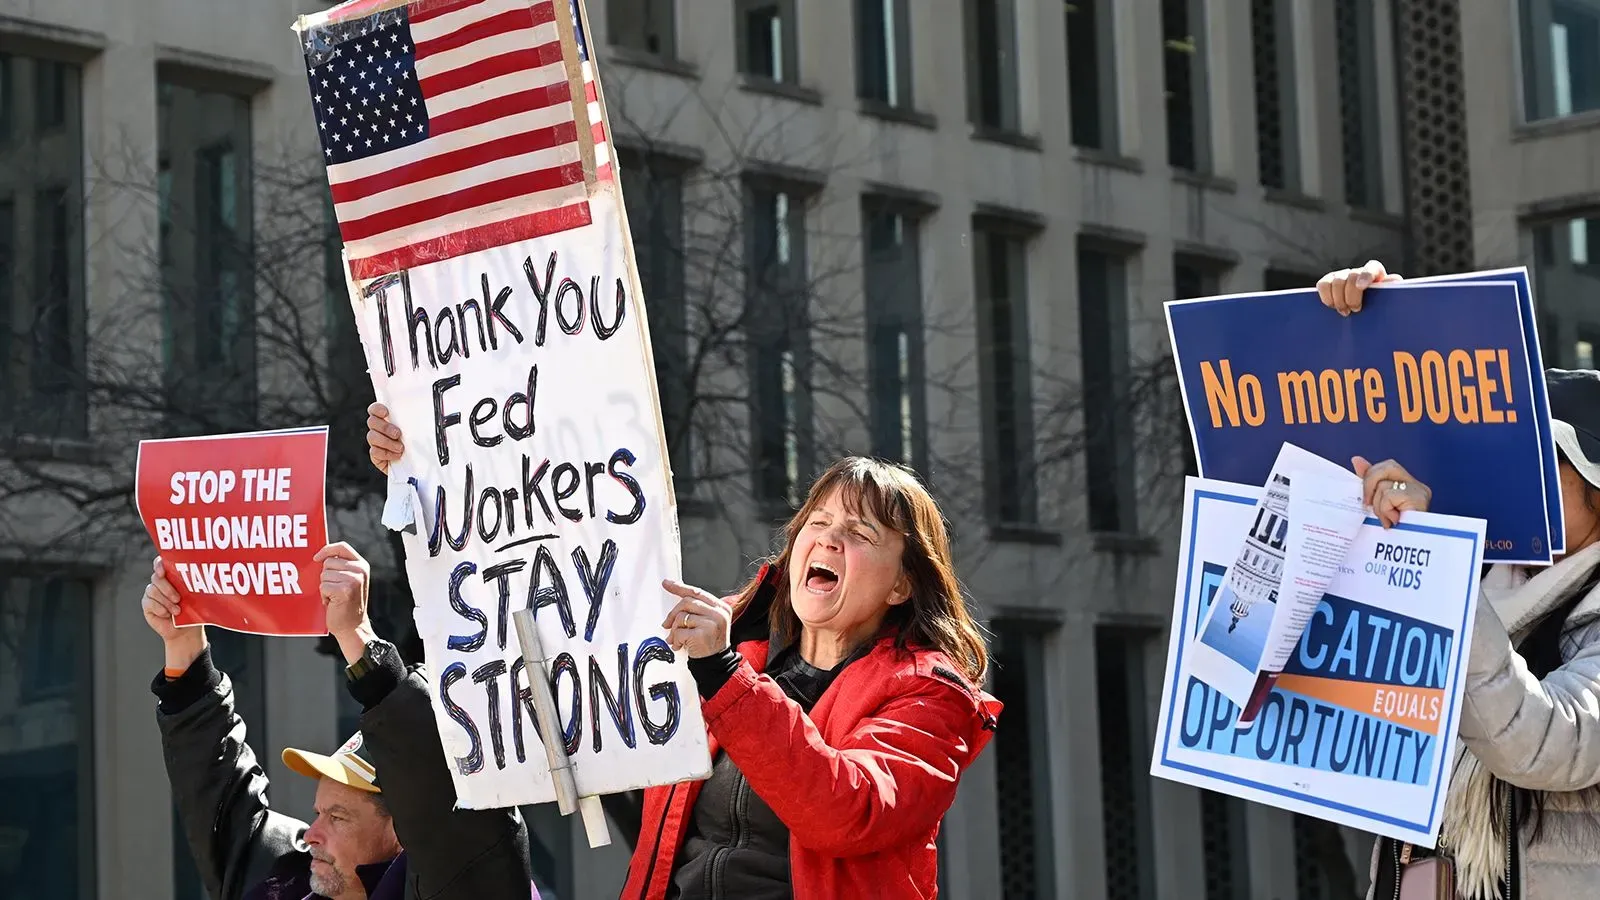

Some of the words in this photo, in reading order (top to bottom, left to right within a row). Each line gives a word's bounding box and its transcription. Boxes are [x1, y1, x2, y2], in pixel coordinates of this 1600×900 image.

[363, 270, 524, 377] Thank
[1200, 358, 1266, 429] No
[1277, 366, 1387, 425] more
[1393, 348, 1518, 425] DOGE!
[432, 363, 538, 466] Fed
[169, 470, 236, 505] STOP
[241, 467, 292, 503] THE
[154, 514, 309, 550] BILLIONAIRE
[1484, 539, 1513, 551] FL-CIO
[1374, 542, 1431, 568] PROTECT
[175, 561, 303, 596] TAKEOVER
[446, 538, 619, 652] STAY
[1364, 561, 1388, 576] OUR
[1387, 566, 1423, 591] KIDS
[1196, 571, 1453, 689] CATION
[440, 635, 682, 776] STRONG
[1373, 689, 1440, 721] EQUALS
